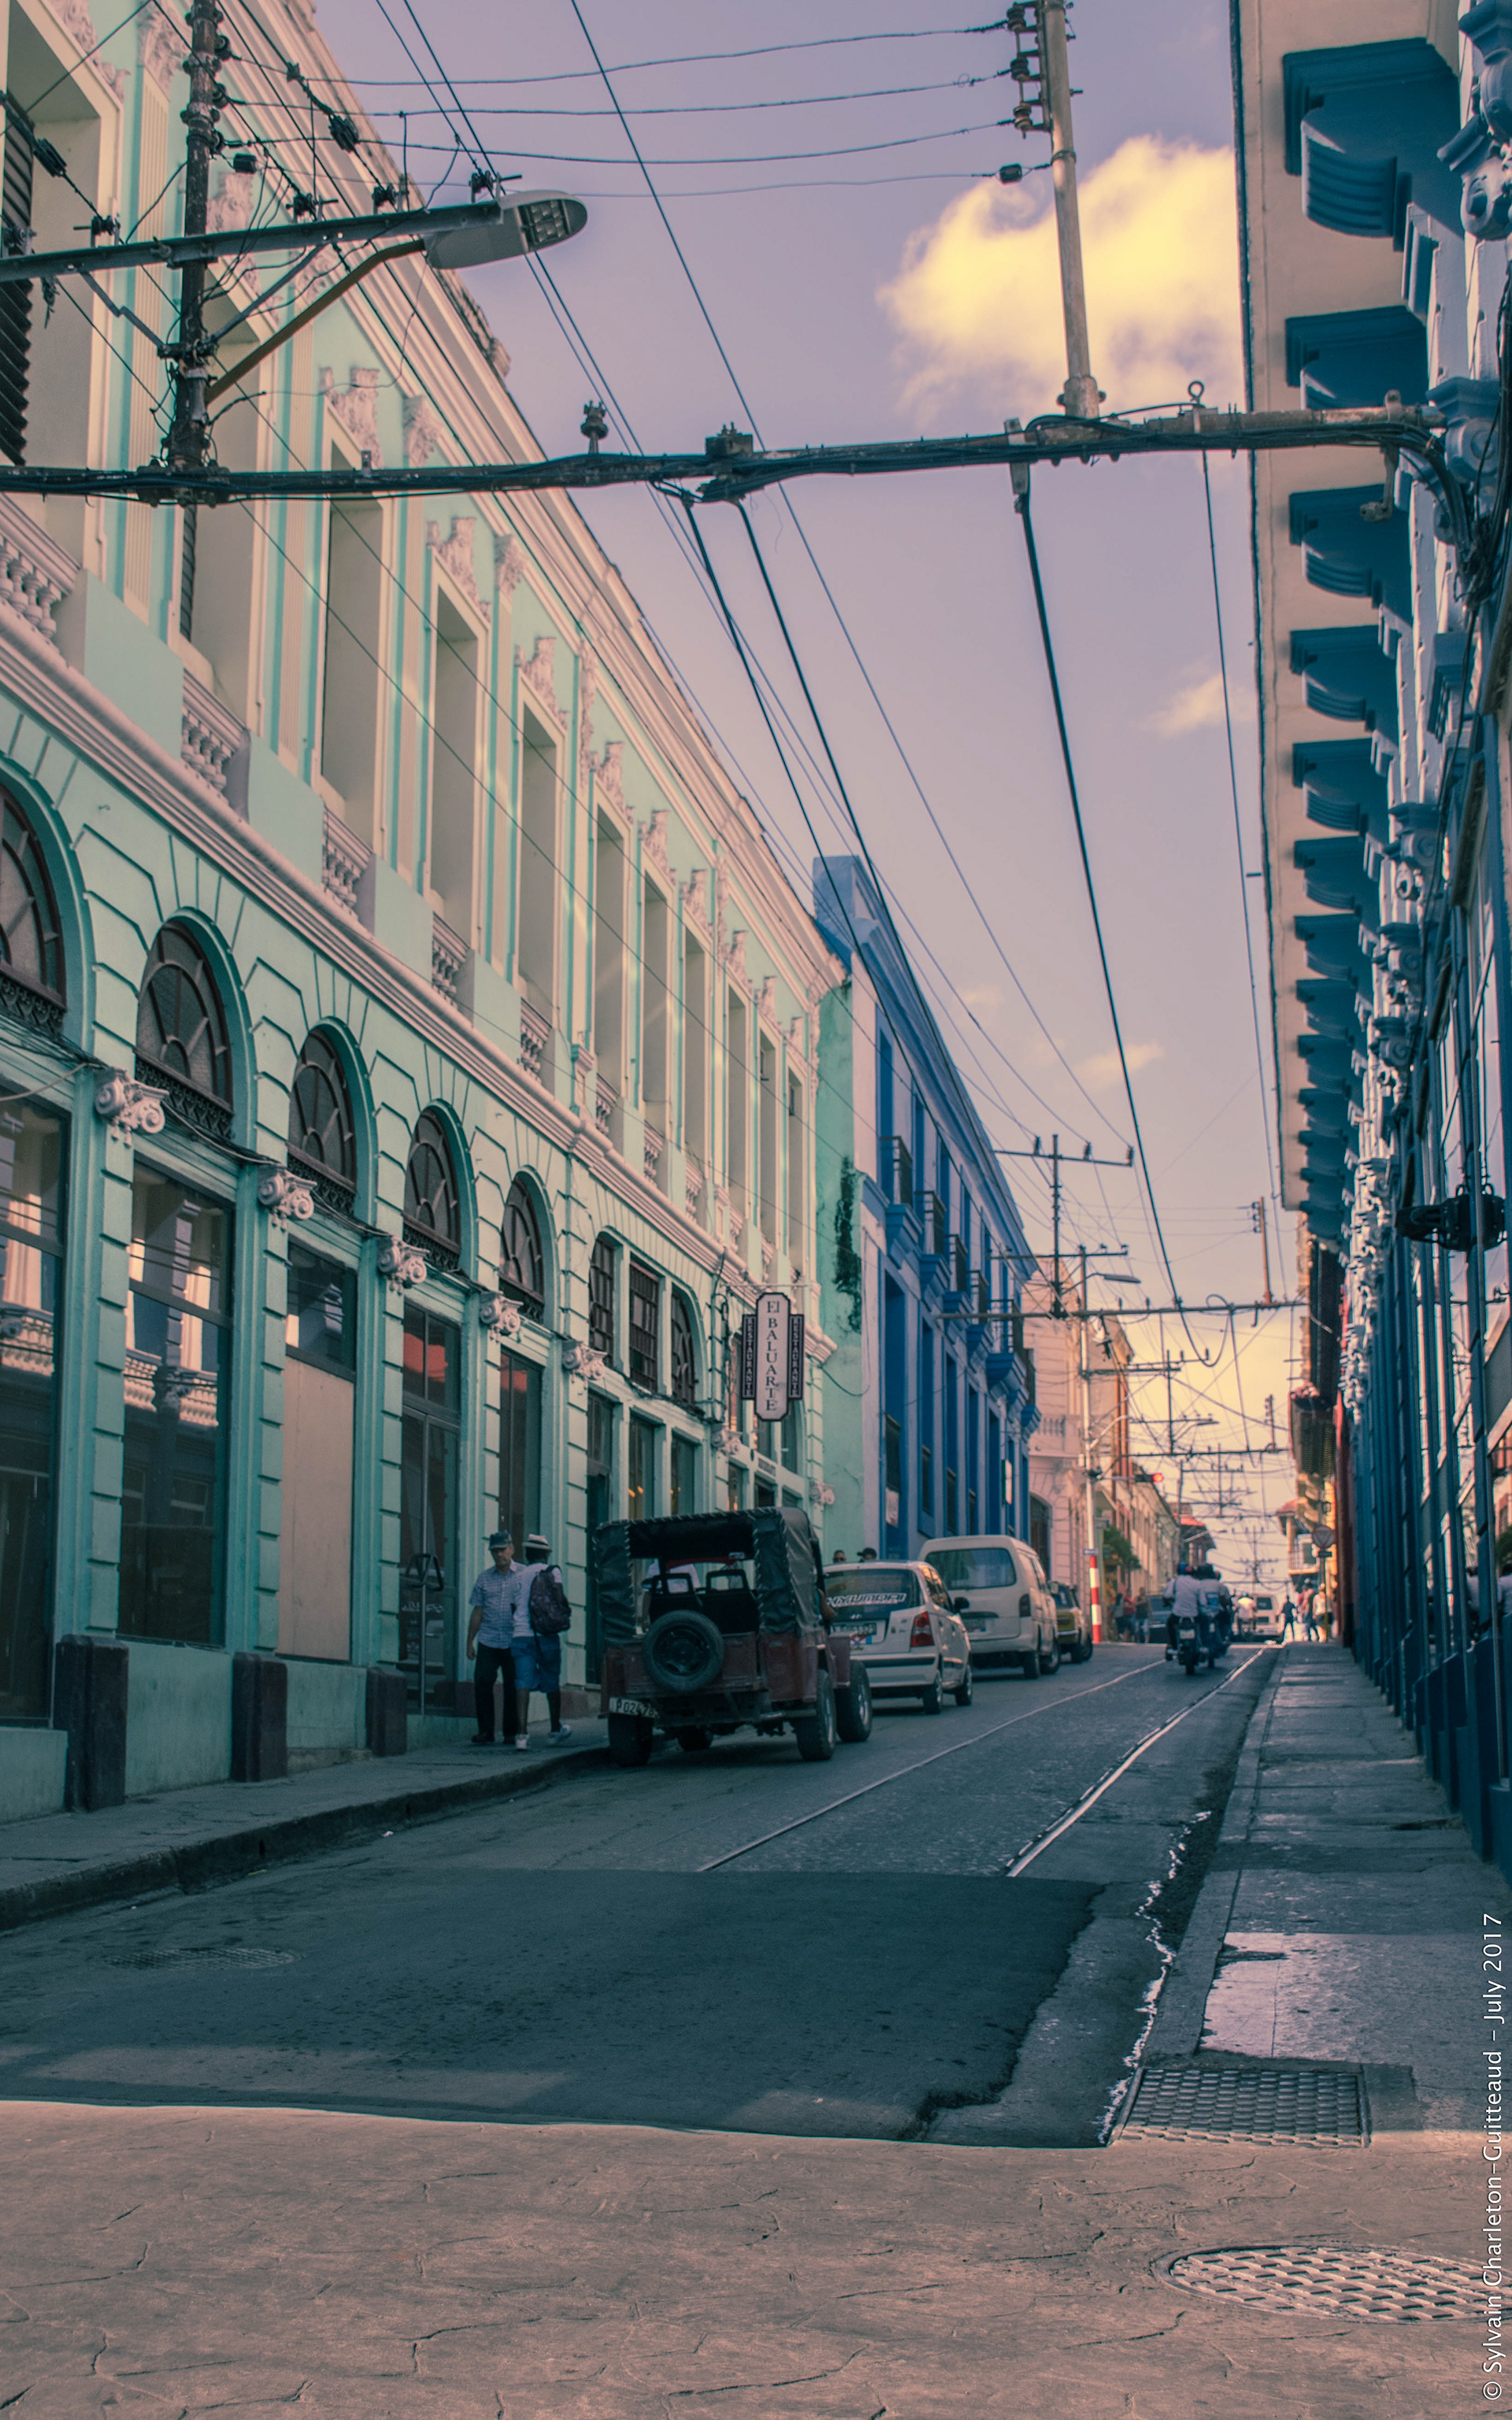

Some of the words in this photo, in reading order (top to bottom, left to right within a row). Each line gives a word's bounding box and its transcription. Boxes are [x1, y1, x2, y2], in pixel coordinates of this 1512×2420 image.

[766, 1301, 780, 1313] El
[745, 1318, 754, 1396] RESTAURANTE
[765, 1317, 780, 1411] BALUARTE
